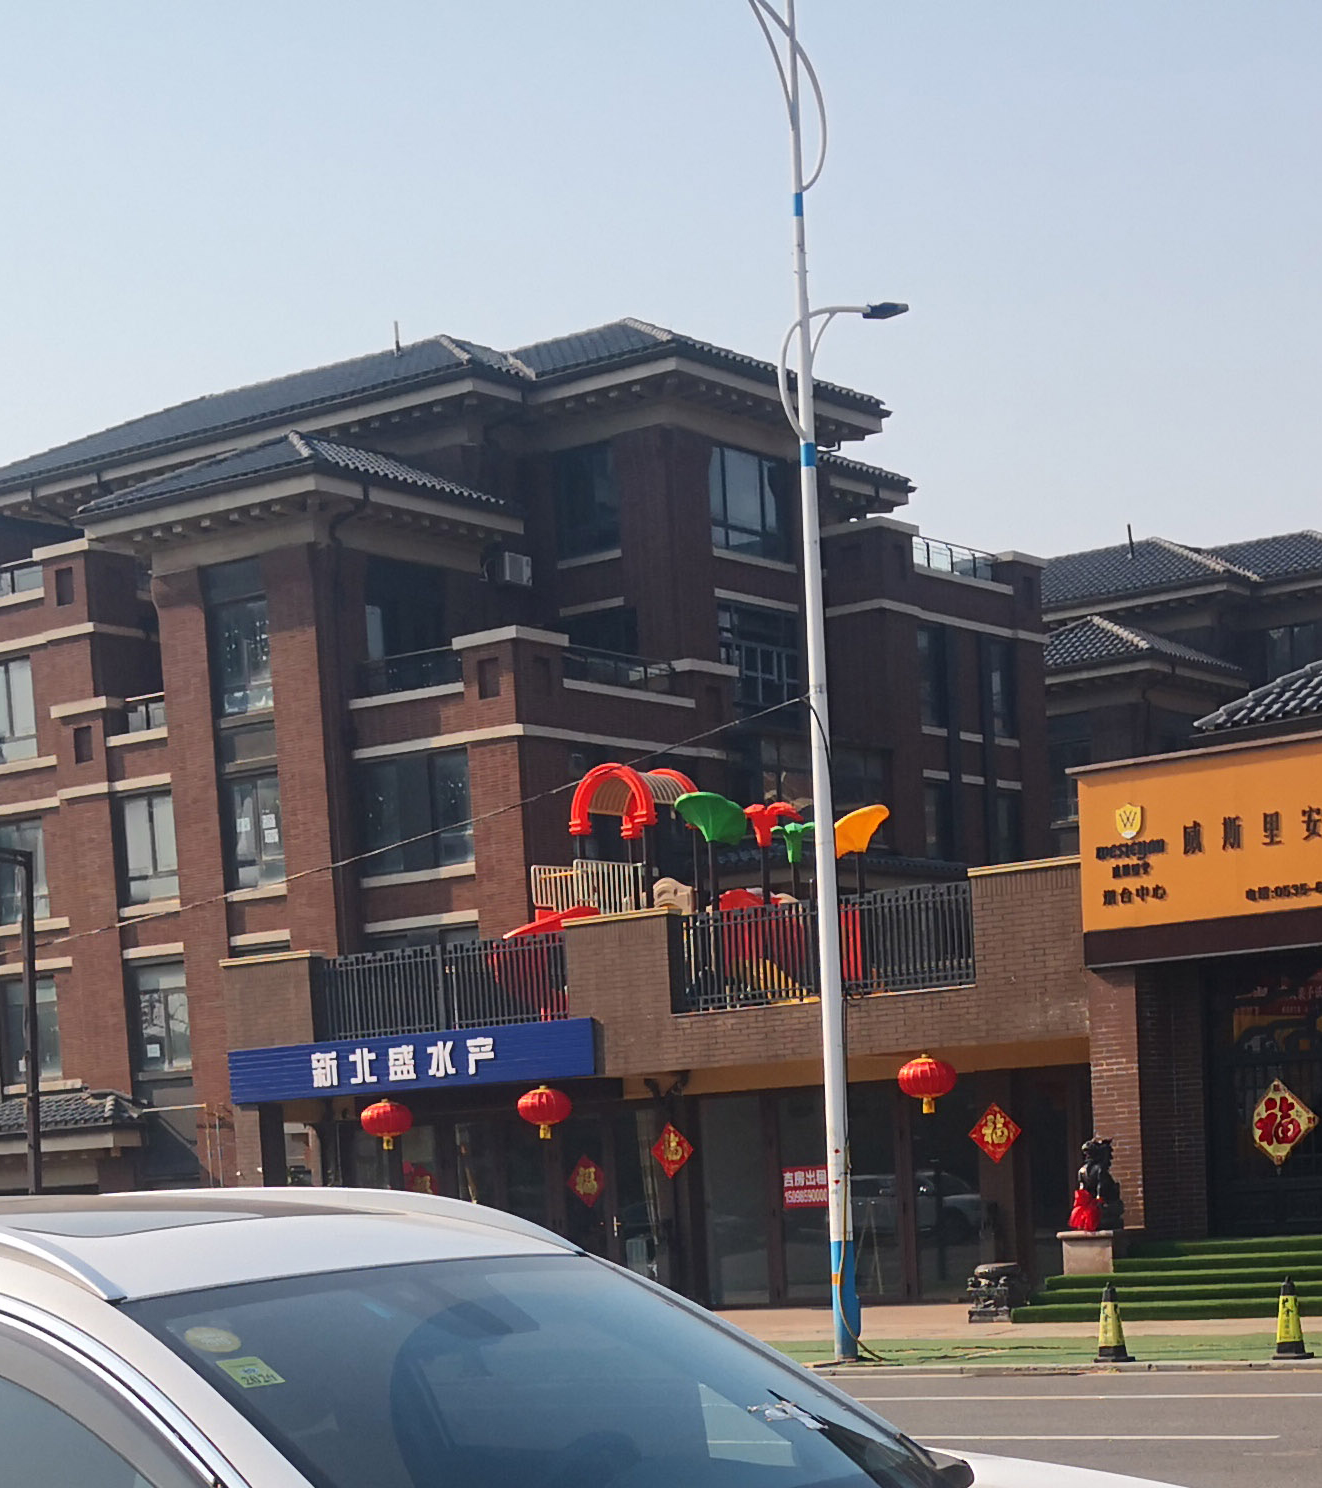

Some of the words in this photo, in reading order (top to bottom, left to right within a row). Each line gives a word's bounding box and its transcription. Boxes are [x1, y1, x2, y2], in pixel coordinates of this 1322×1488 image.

[310, 1036, 496, 1089] 新北盛水产
[981, 1113, 1009, 1145] 福
[1255, 1096, 1302, 1147] 福
[662, 1132, 683, 1161] 福
